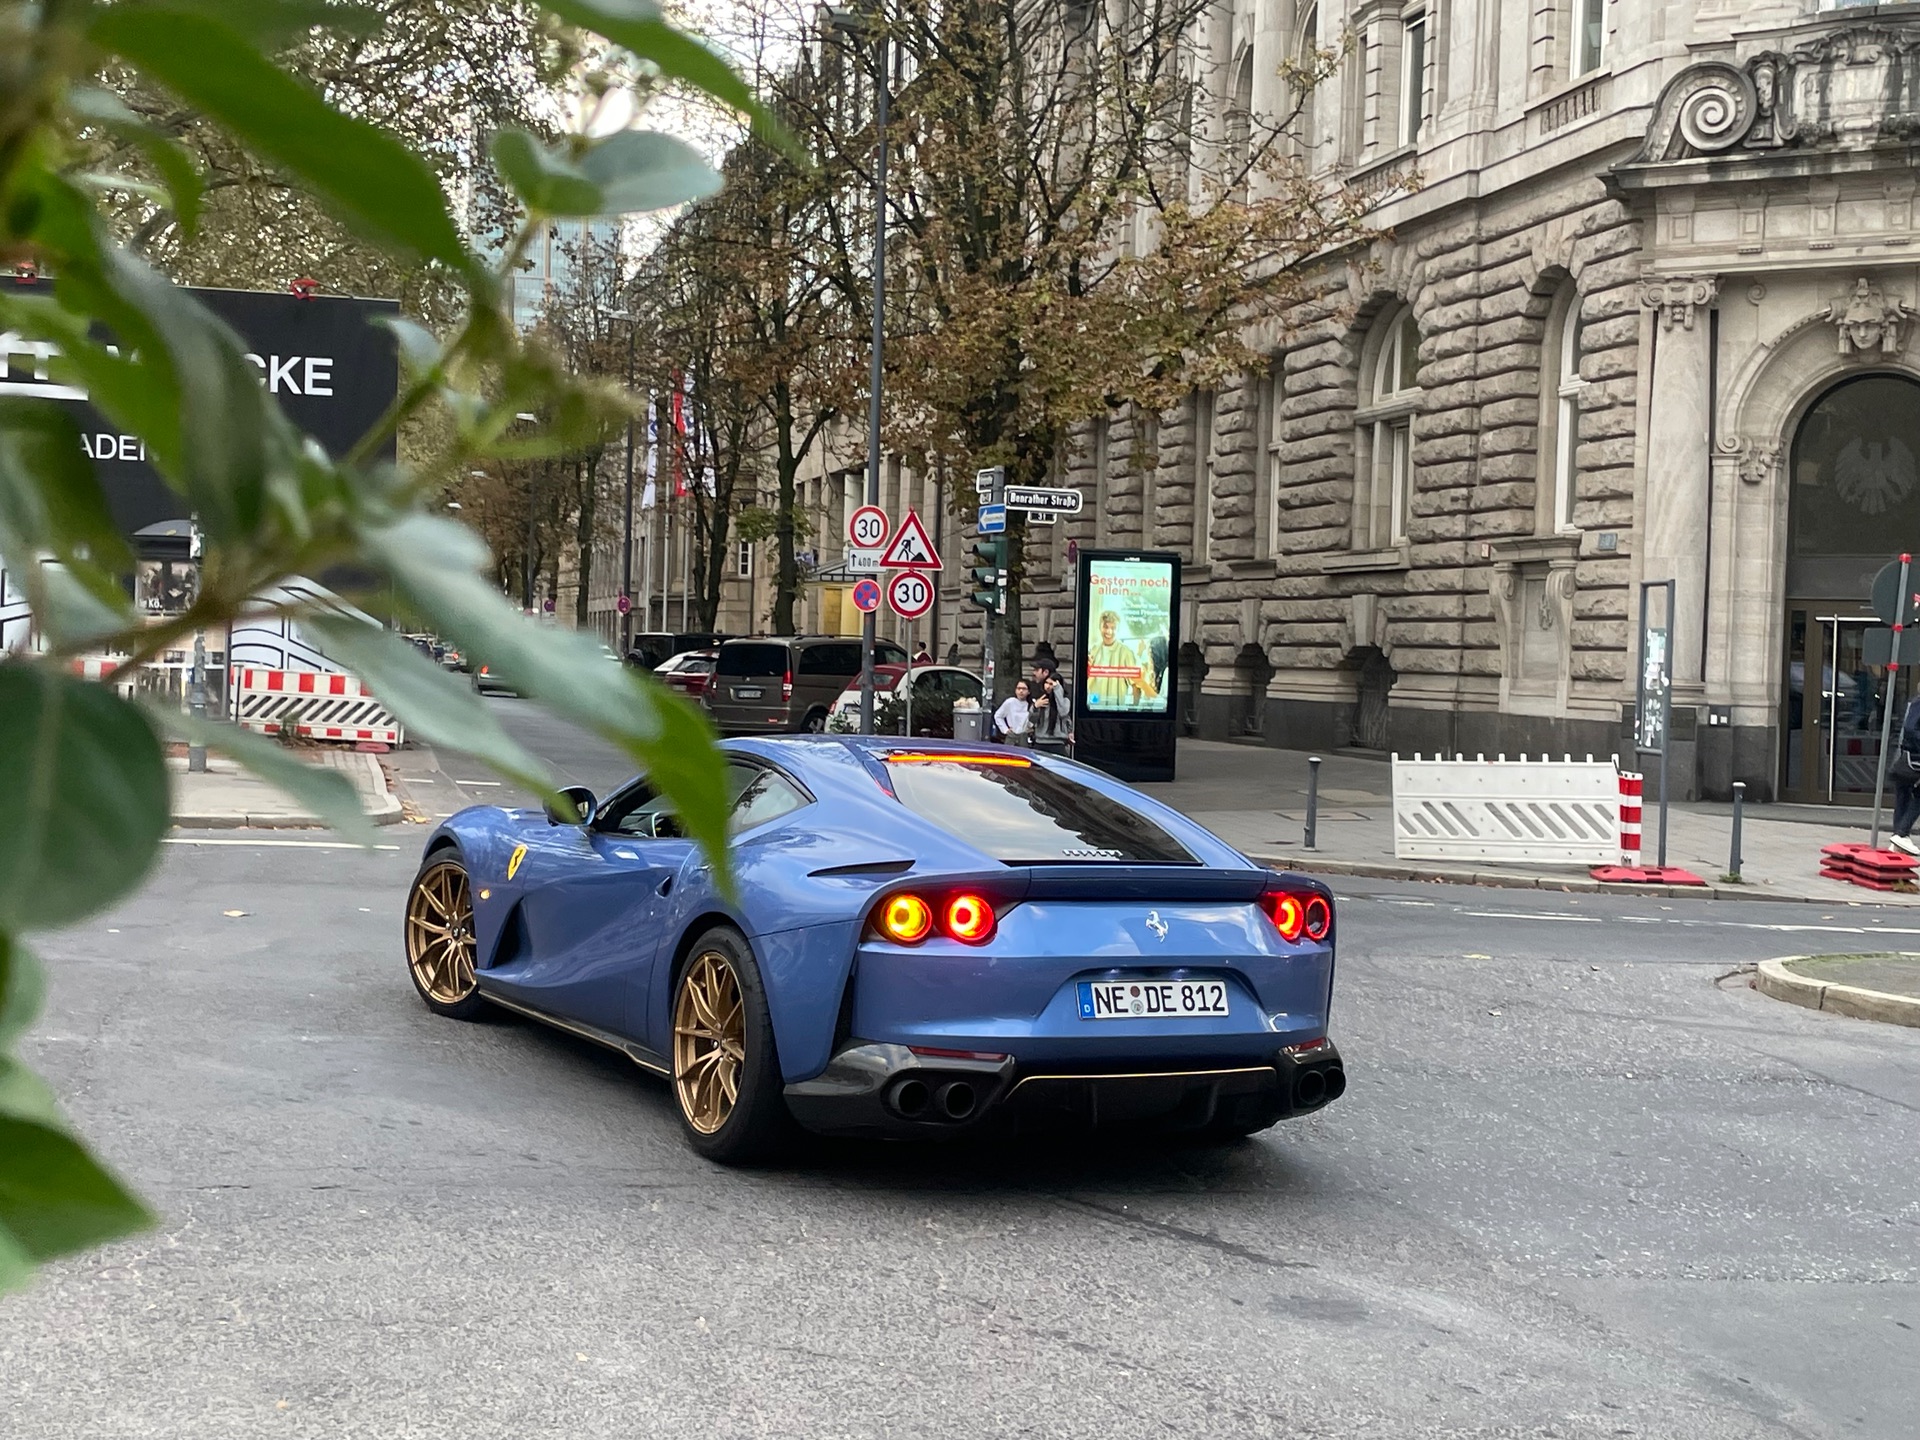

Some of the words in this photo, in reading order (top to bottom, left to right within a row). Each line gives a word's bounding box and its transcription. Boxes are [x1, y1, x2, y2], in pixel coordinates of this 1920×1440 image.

[1010, 492, 1048, 505] Benrather
[1051, 495, 1076, 508] Straße
[857, 518, 880, 539] 30
[858, 557, 871, 567] 400
[1090, 574, 1137, 587] Gestern
[1141, 577, 1169, 588] noch
[897, 582, 925, 604] 30
[1094, 986, 1129, 1014] NE
[1145, 985, 1177, 1013] DE
[1181, 984, 1225, 1012] 812
